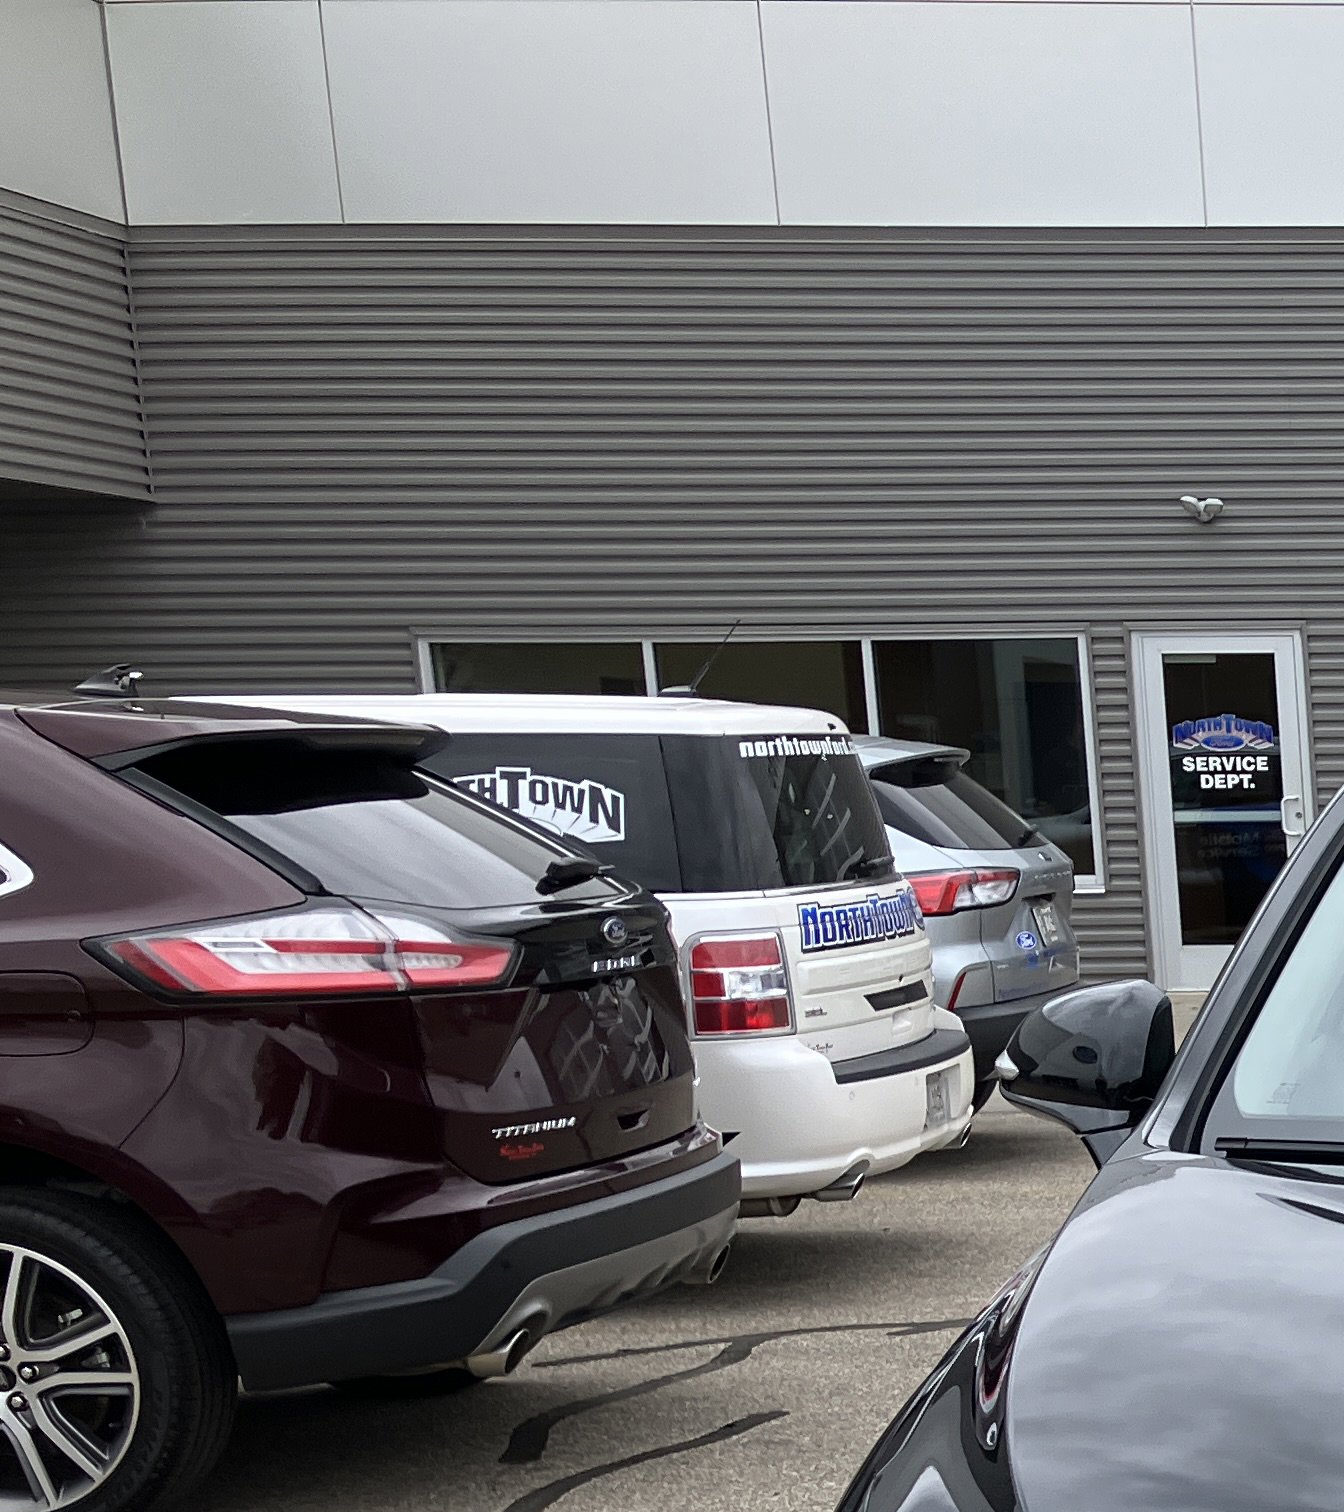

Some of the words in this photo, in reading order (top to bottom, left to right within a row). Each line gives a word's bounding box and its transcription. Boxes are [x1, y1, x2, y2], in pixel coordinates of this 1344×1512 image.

[1182, 756, 1269, 772] SERVICE
[1200, 774, 1256, 789] DEPT.
[491, 1115, 577, 1140] TITANIUM
